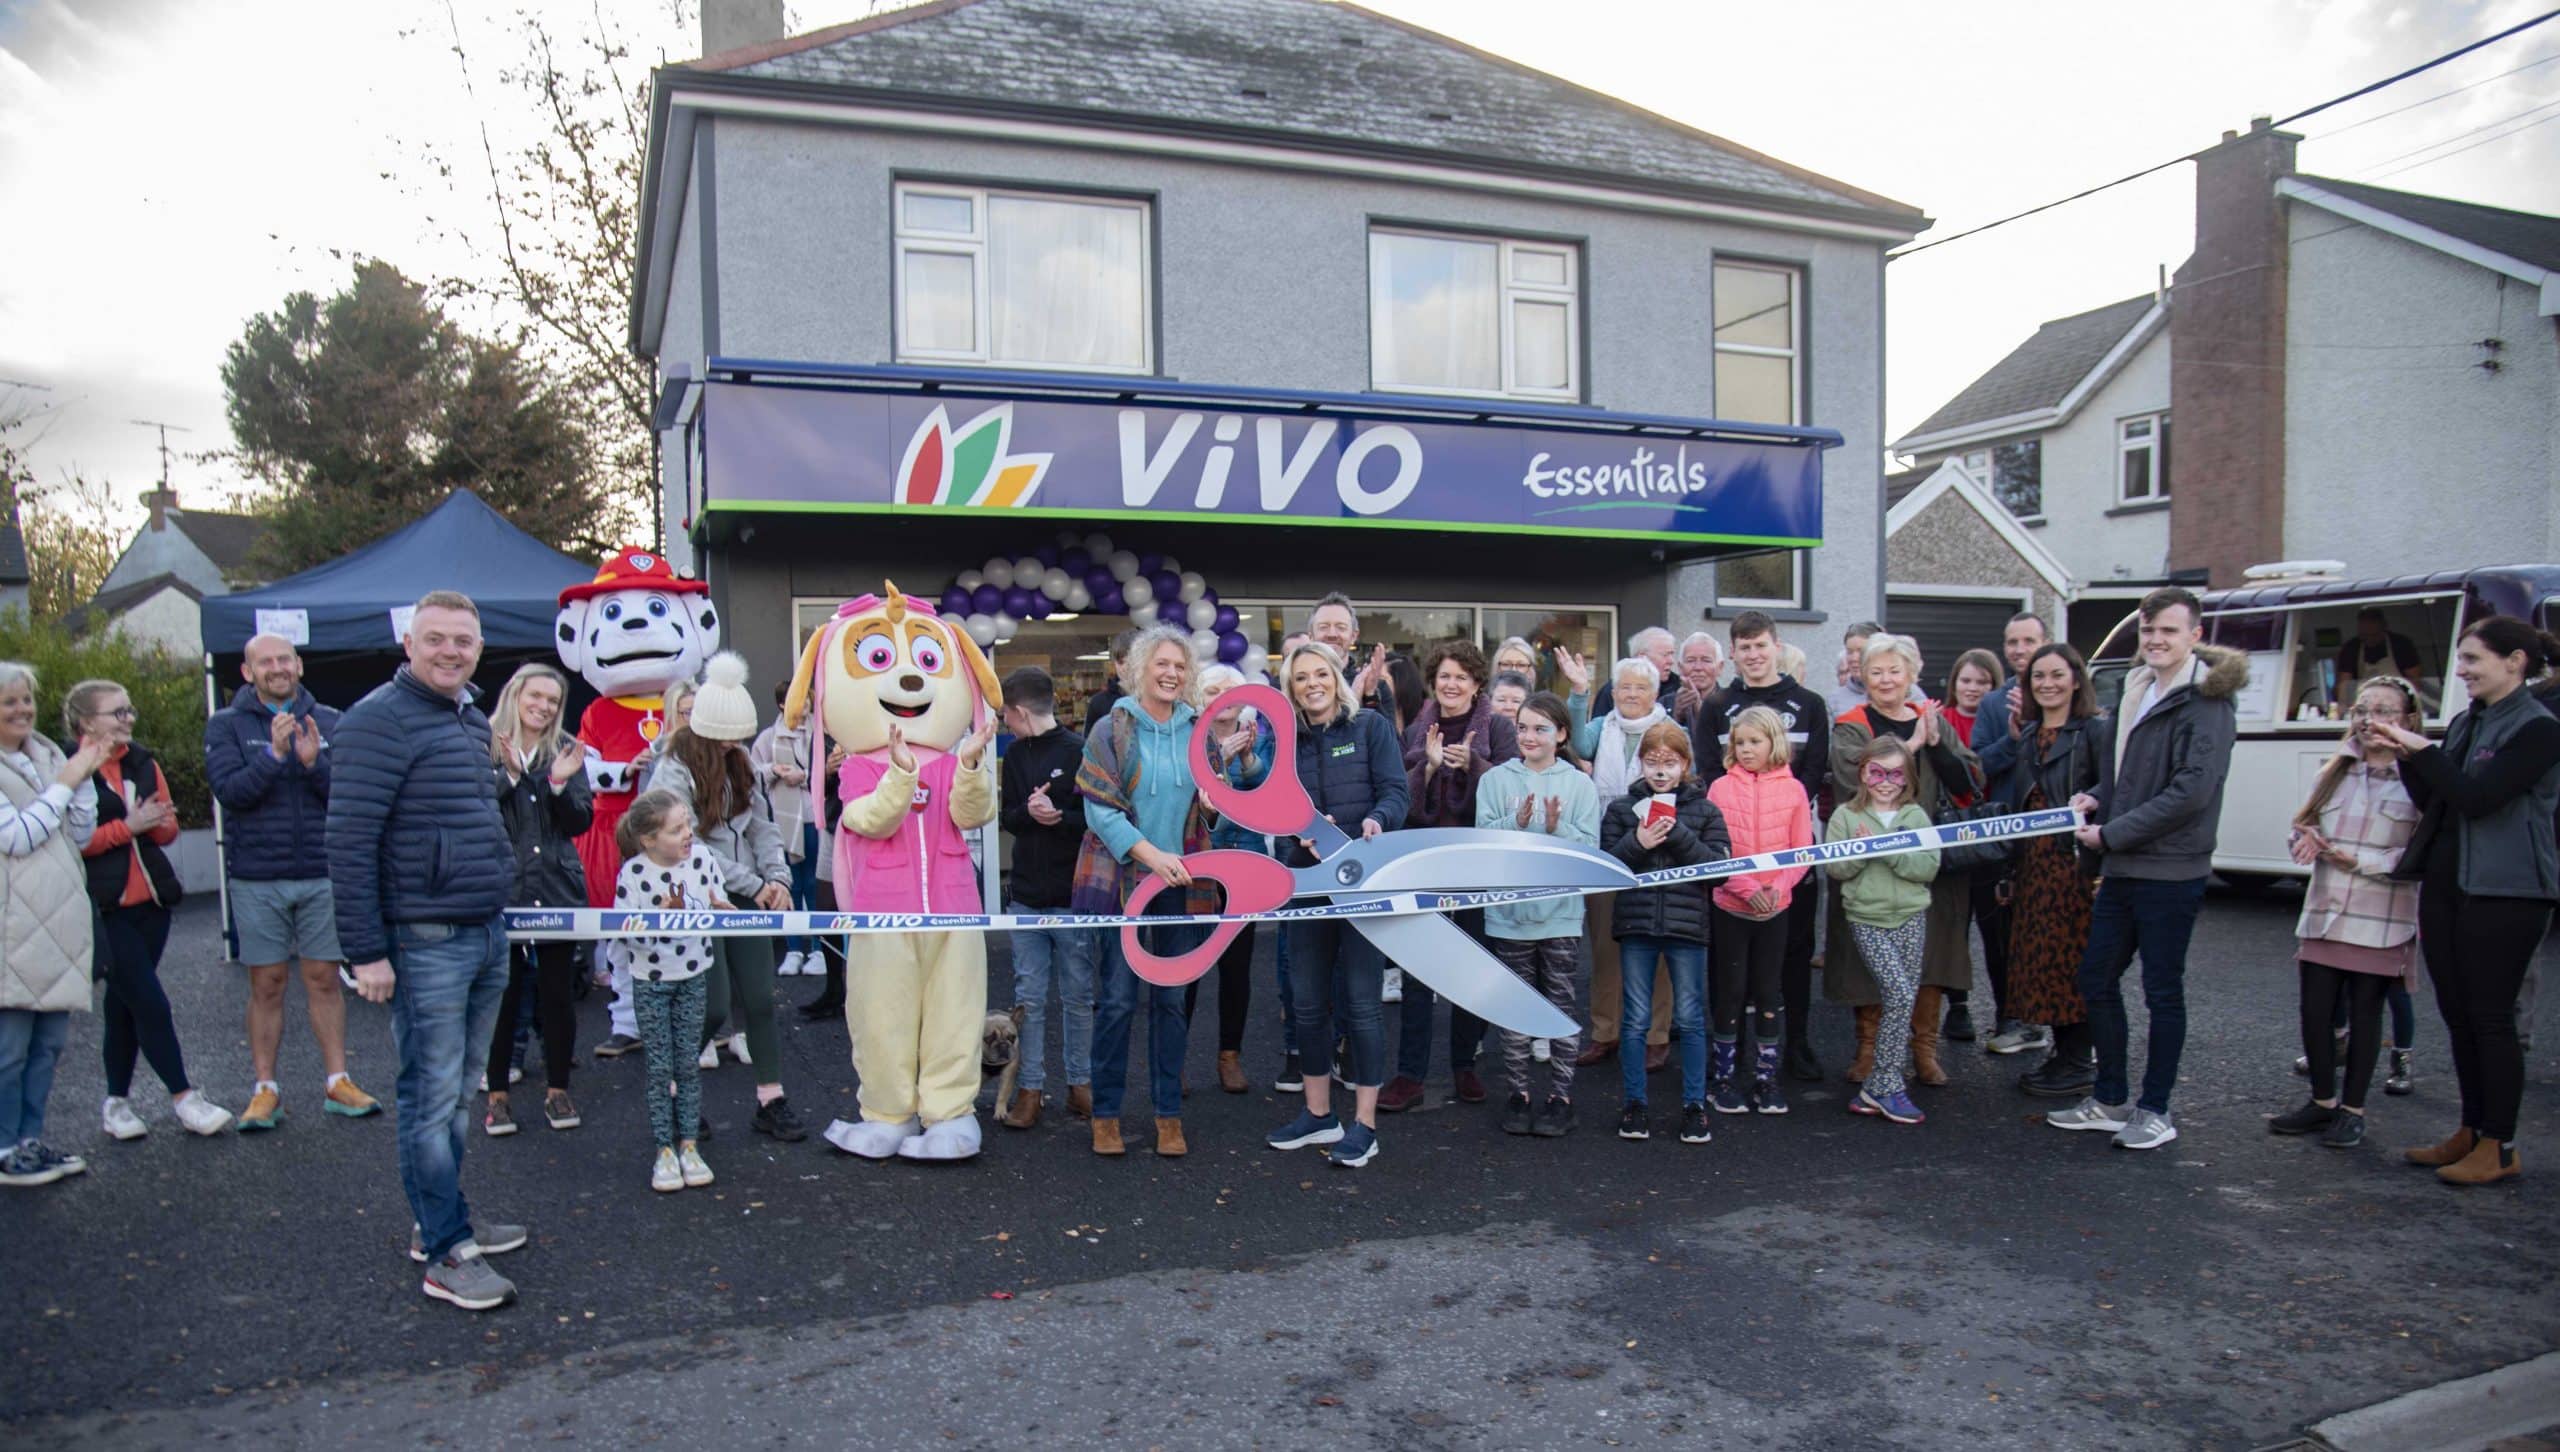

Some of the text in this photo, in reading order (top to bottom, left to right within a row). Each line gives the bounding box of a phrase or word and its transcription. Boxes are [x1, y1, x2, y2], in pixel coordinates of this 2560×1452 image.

[1118, 410, 1708, 515] ViVO Essentials
[1819, 841, 1867, 858] ViVO
[512, 914, 564, 929] Essentials
[659, 913, 773, 930] ViVO Essentials
[867, 915, 923, 927] ViVO
